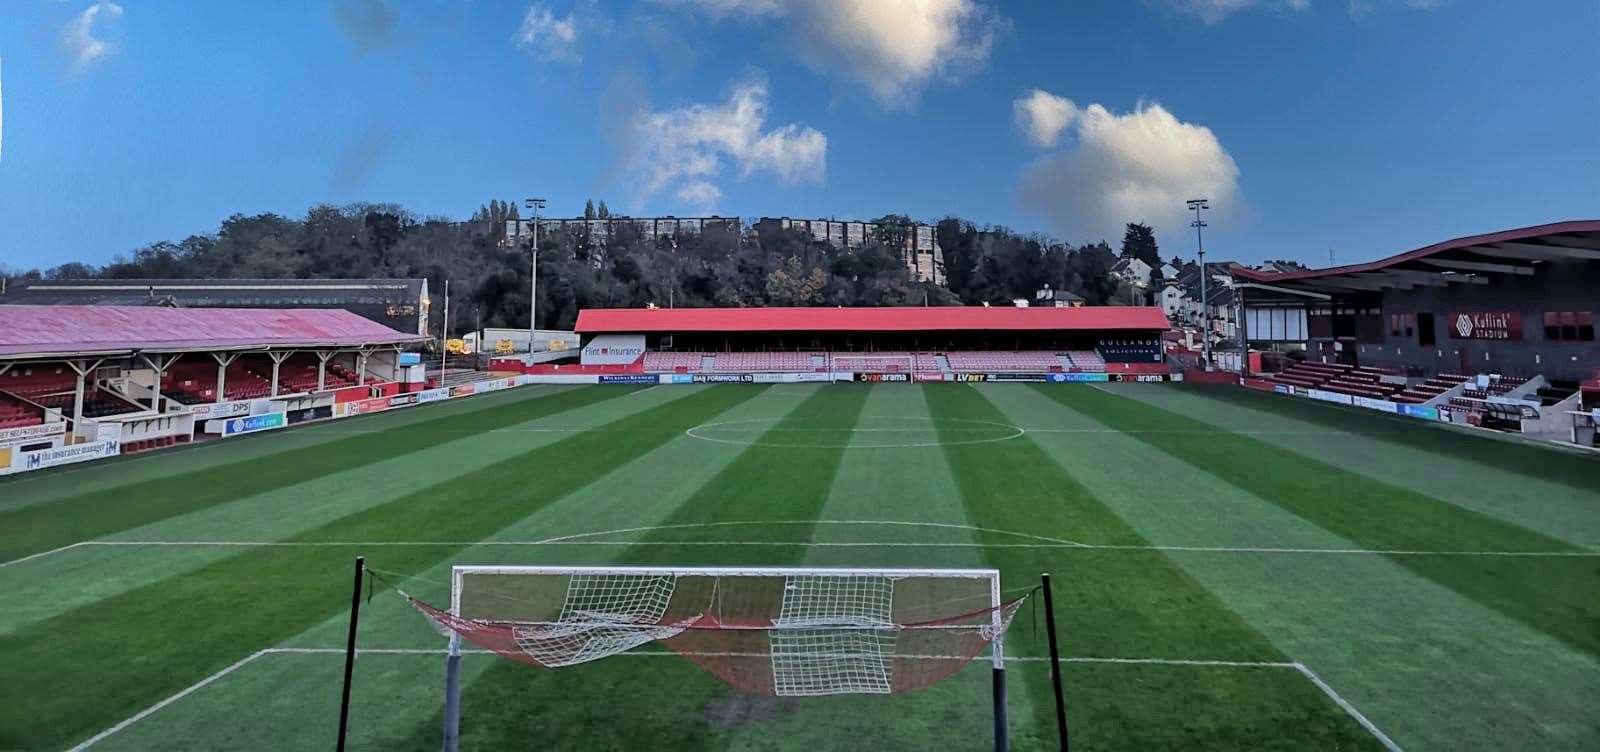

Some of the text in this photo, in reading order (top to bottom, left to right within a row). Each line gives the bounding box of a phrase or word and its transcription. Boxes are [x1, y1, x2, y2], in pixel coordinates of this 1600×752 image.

[1476, 330, 1508, 338] STADIUM
[585, 346, 641, 356] Flint Insurance
